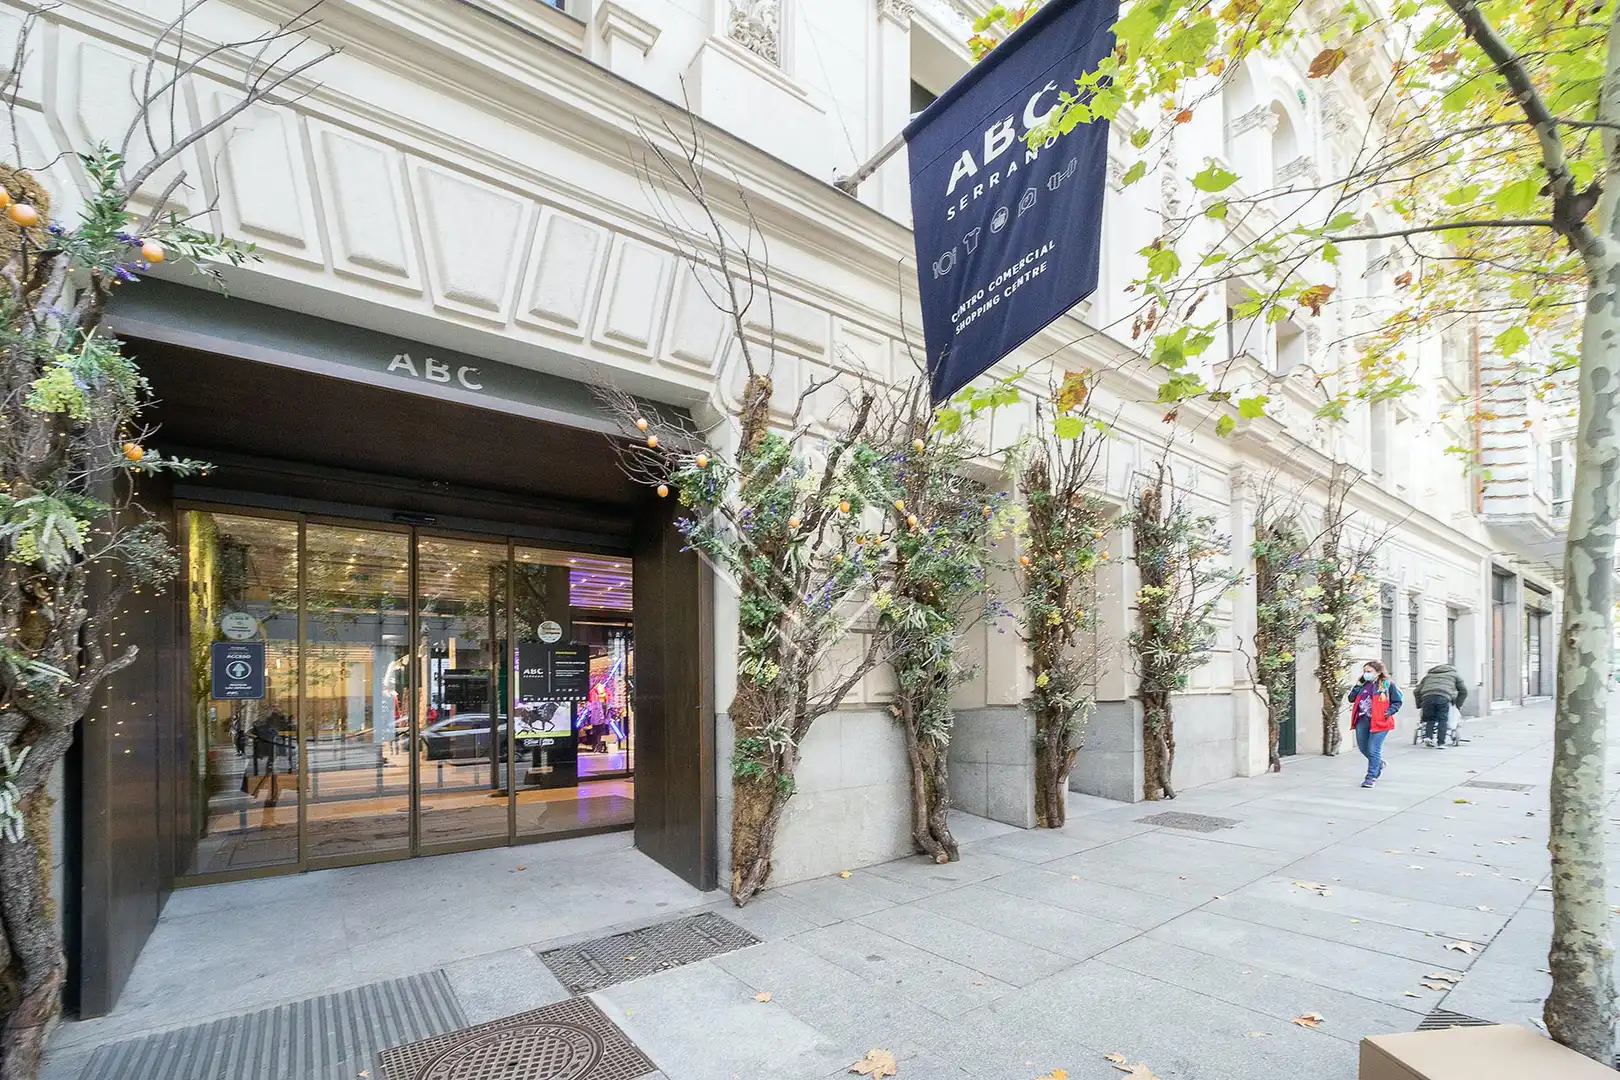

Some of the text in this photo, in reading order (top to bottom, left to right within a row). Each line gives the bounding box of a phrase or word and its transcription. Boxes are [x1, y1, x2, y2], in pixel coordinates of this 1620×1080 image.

[946, 80, 1059, 197] ABC
[947, 135, 1059, 221] SERRANO
[988, 240, 1055, 292] COMERCIAL
[955, 261, 1048, 335] SHOPPING CENTRE
[387, 353, 483, 390] ABC
[533, 1027, 585, 1046] ISABEL
